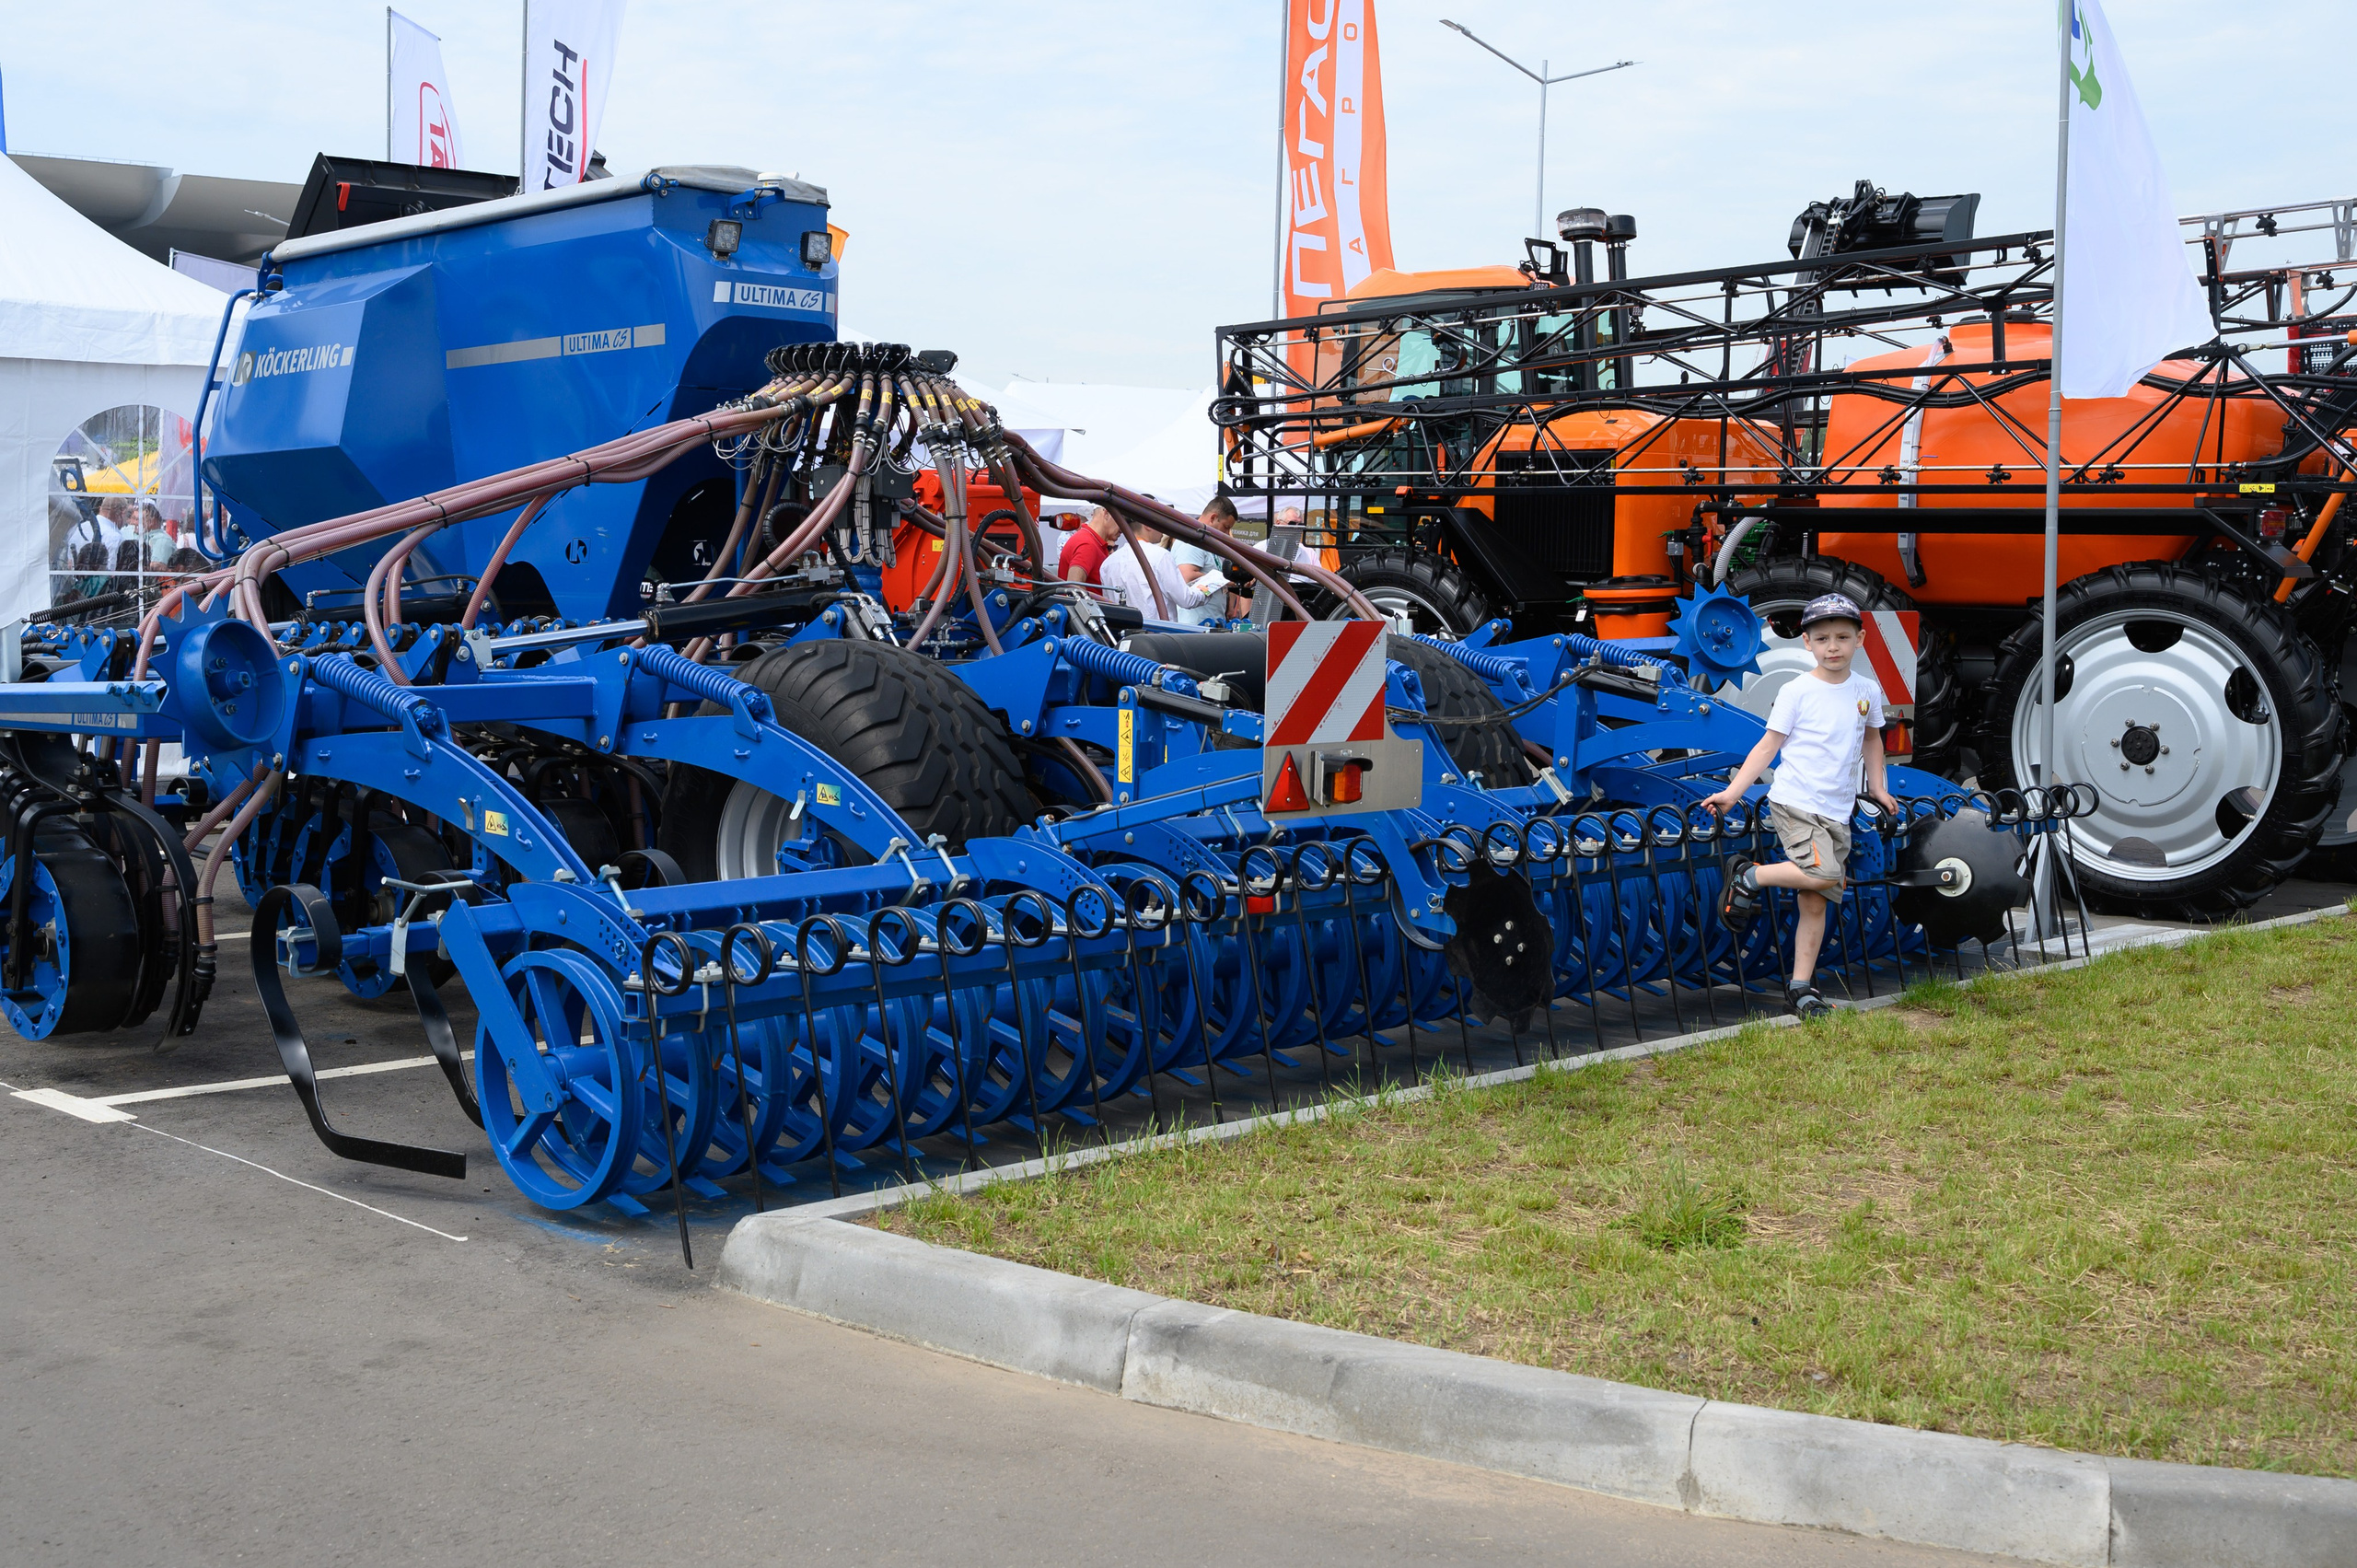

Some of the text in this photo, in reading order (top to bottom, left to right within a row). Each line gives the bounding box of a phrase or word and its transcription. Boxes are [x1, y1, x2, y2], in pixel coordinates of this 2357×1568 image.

[1341, 22, 1364, 255] АГРО
[740, 285, 820, 308] ULTIMA CS
[569, 330, 628, 353] ULTIMA CS
[254, 343, 341, 378] KÖCKERLING
